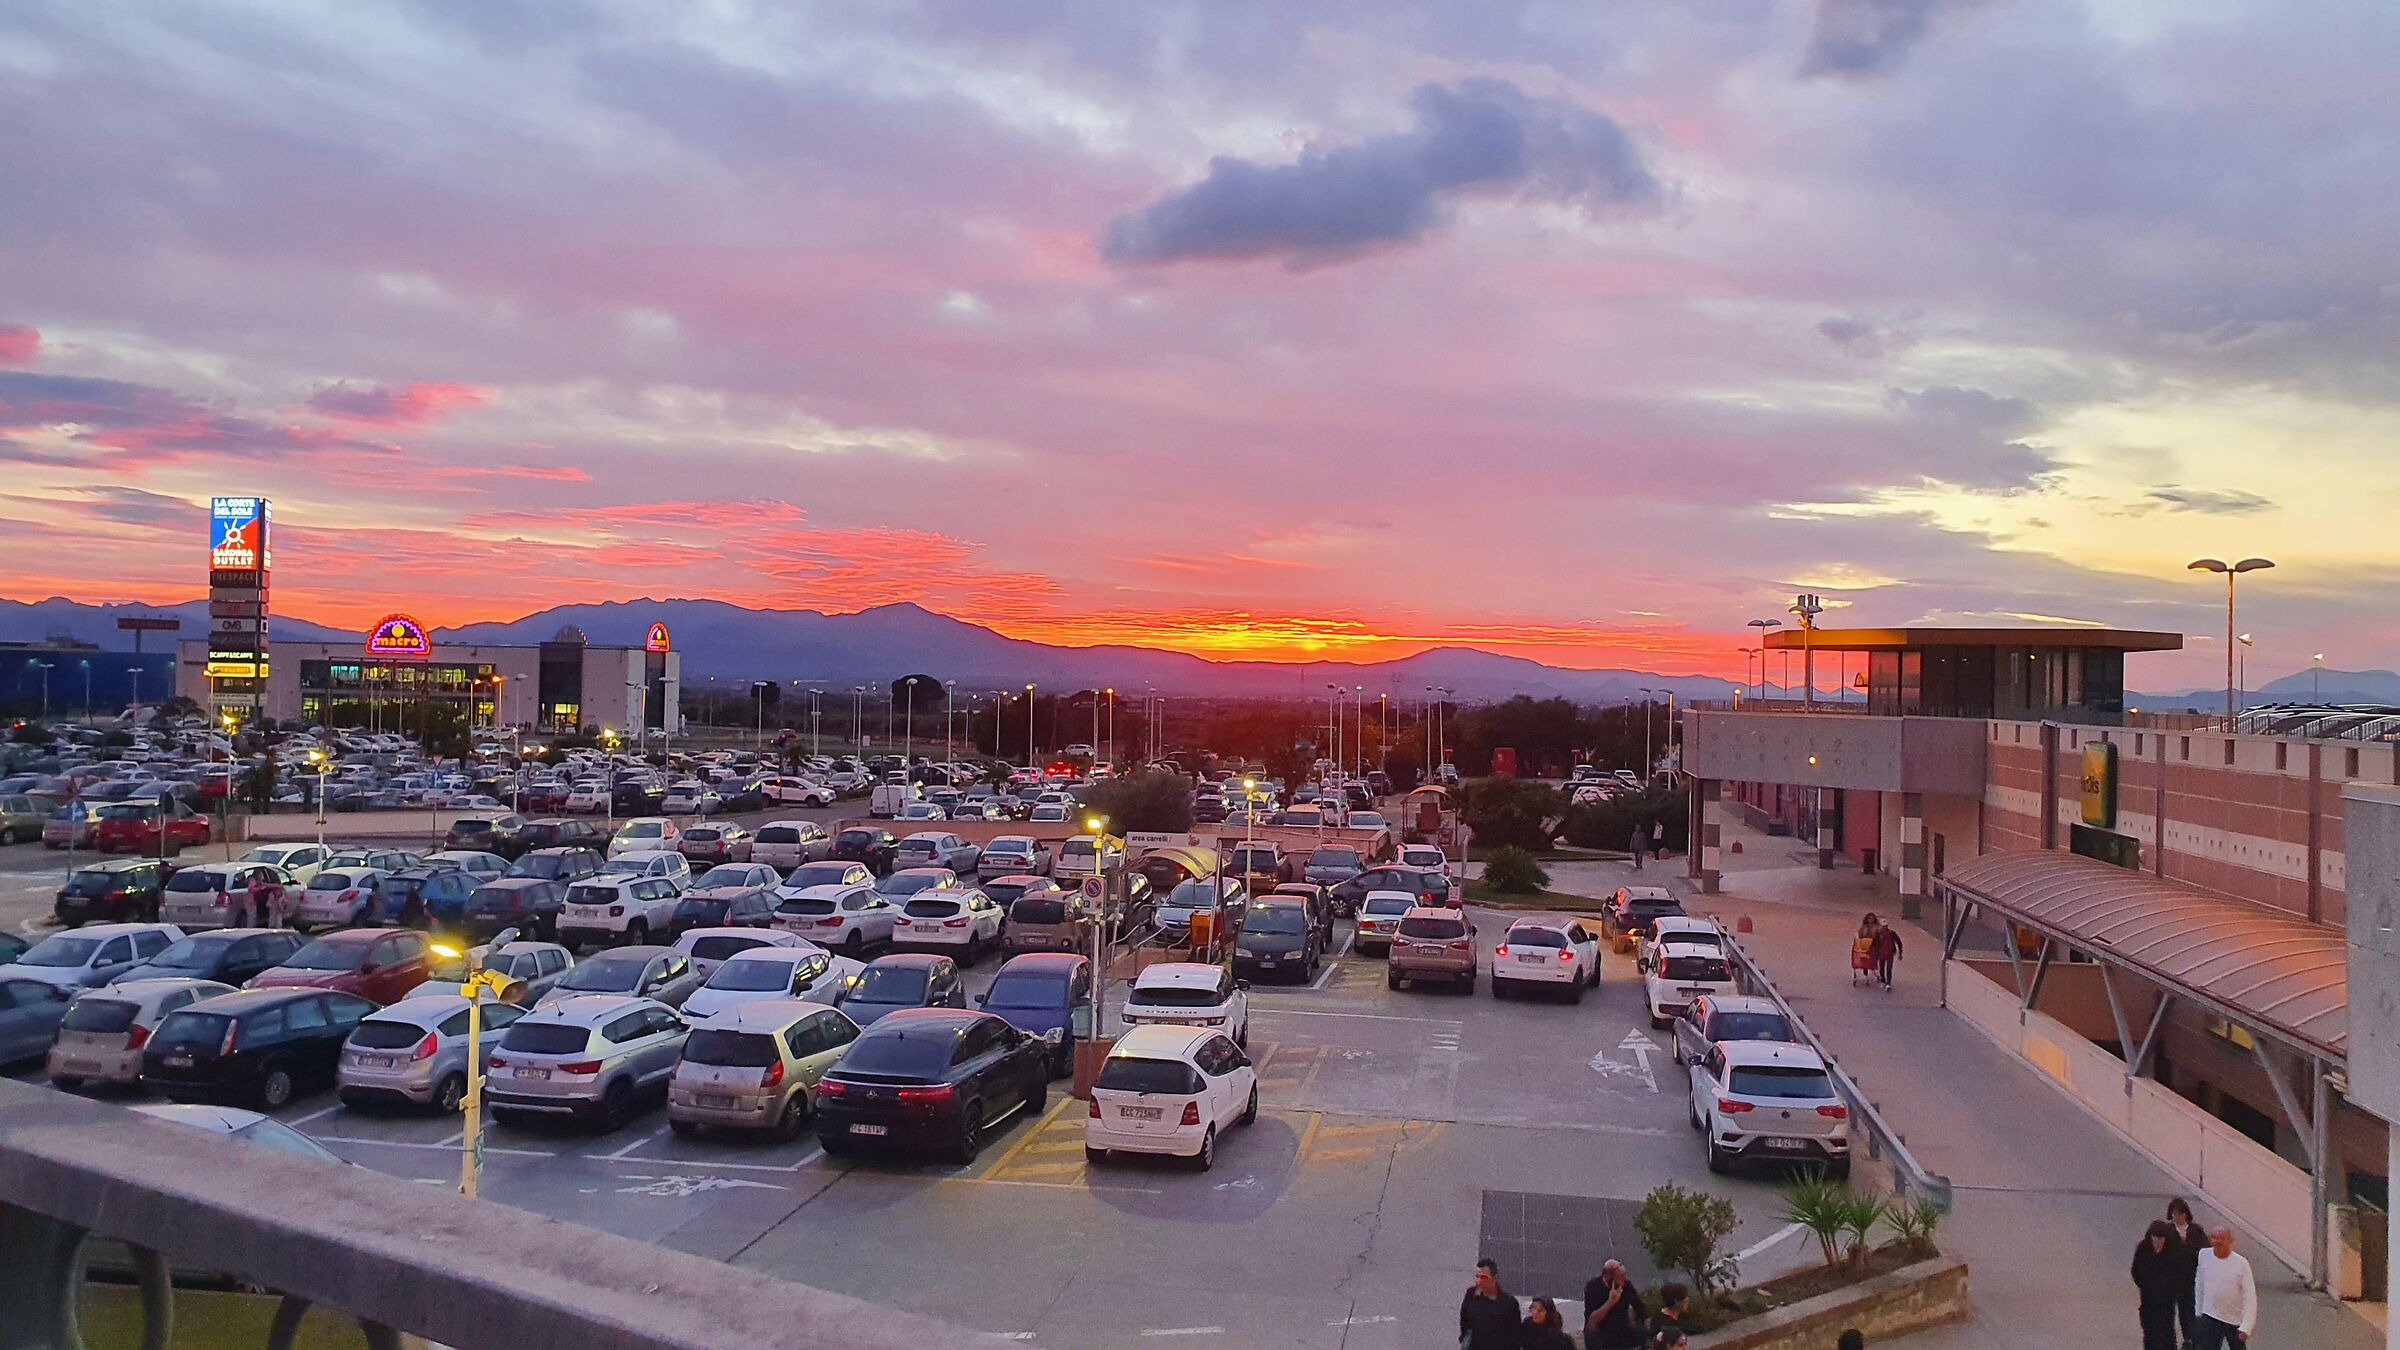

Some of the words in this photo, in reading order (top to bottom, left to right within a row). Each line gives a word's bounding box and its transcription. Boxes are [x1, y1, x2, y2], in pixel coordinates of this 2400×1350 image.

[214, 498, 227, 507] LA
[227, 498, 255, 508] CORTE
[214, 507, 230, 516] DEL
[231, 507, 253, 516] SOLE
[213, 556, 254, 566] OUTLET
[222, 620, 242, 630] OVS
[377, 637, 419, 646] macro
[1146, 835, 1168, 843] carrelli
